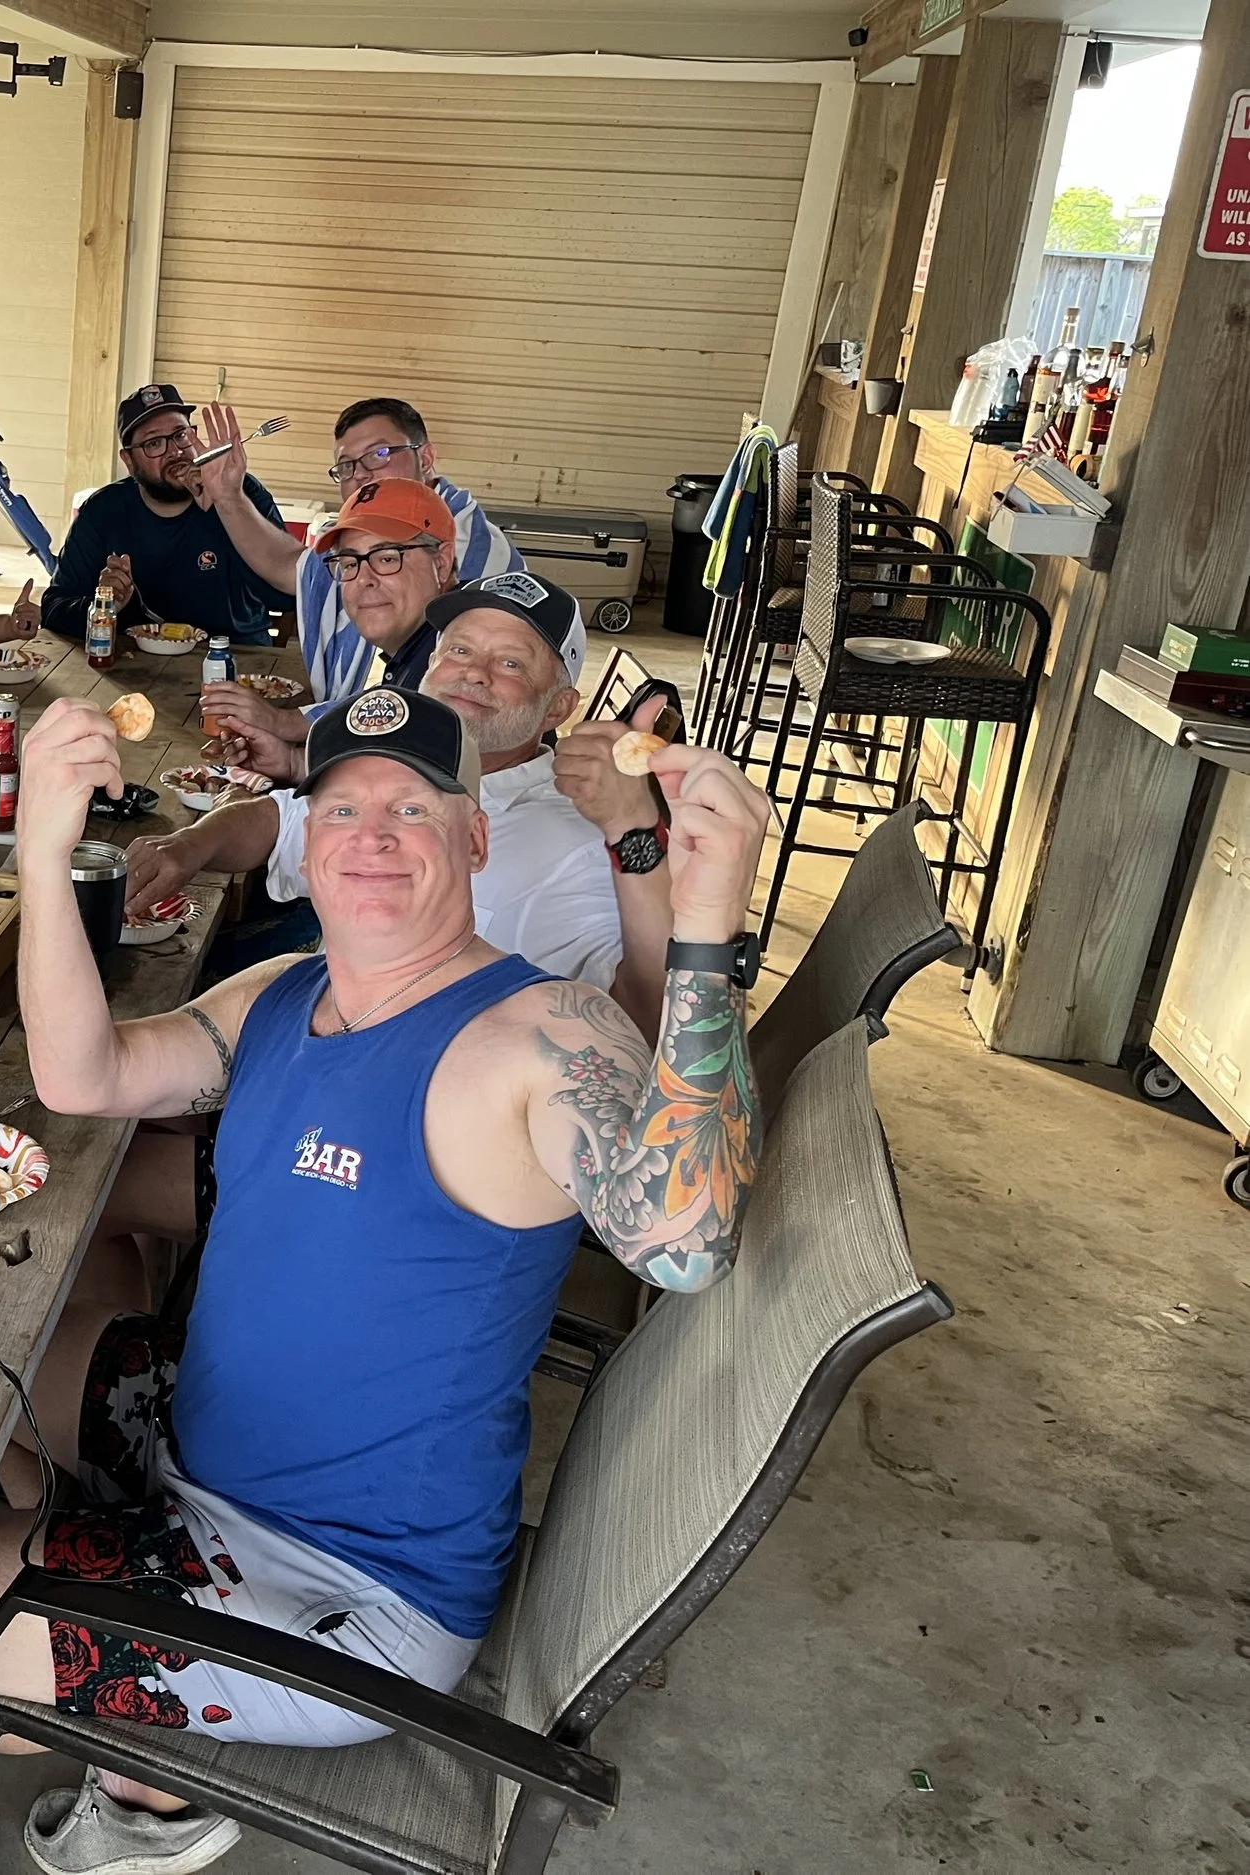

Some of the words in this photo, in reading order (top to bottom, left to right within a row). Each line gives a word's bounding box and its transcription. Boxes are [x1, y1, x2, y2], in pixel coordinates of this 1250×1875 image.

[1225, 231, 1246, 246] AS
[496, 575, 536, 591] COSTA
[358, 709, 395, 720] PLAYA
[296, 1142, 361, 1182] BAR
